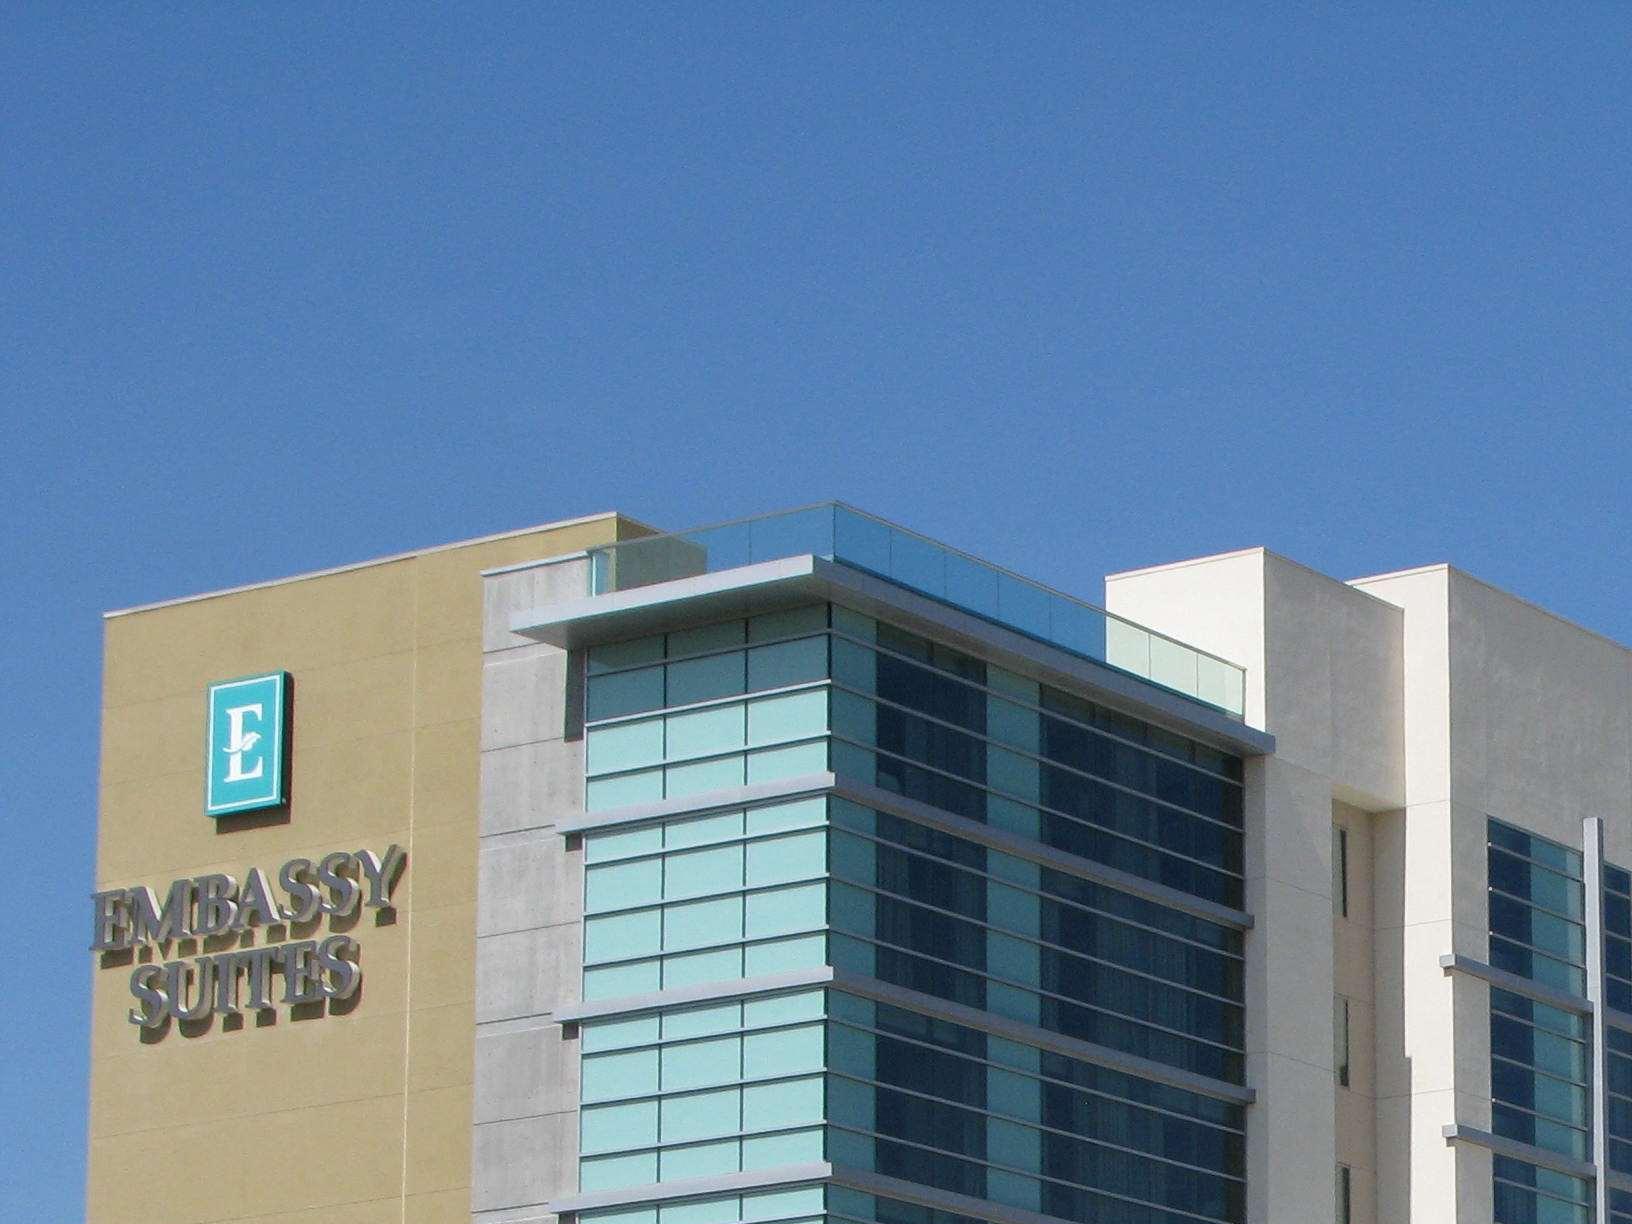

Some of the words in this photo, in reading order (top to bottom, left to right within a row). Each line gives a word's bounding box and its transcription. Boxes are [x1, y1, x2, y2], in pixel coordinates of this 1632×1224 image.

[223, 703, 263, 783] E
[90, 844, 407, 951] EMBASSY
[128, 934, 360, 1028] SUITES
